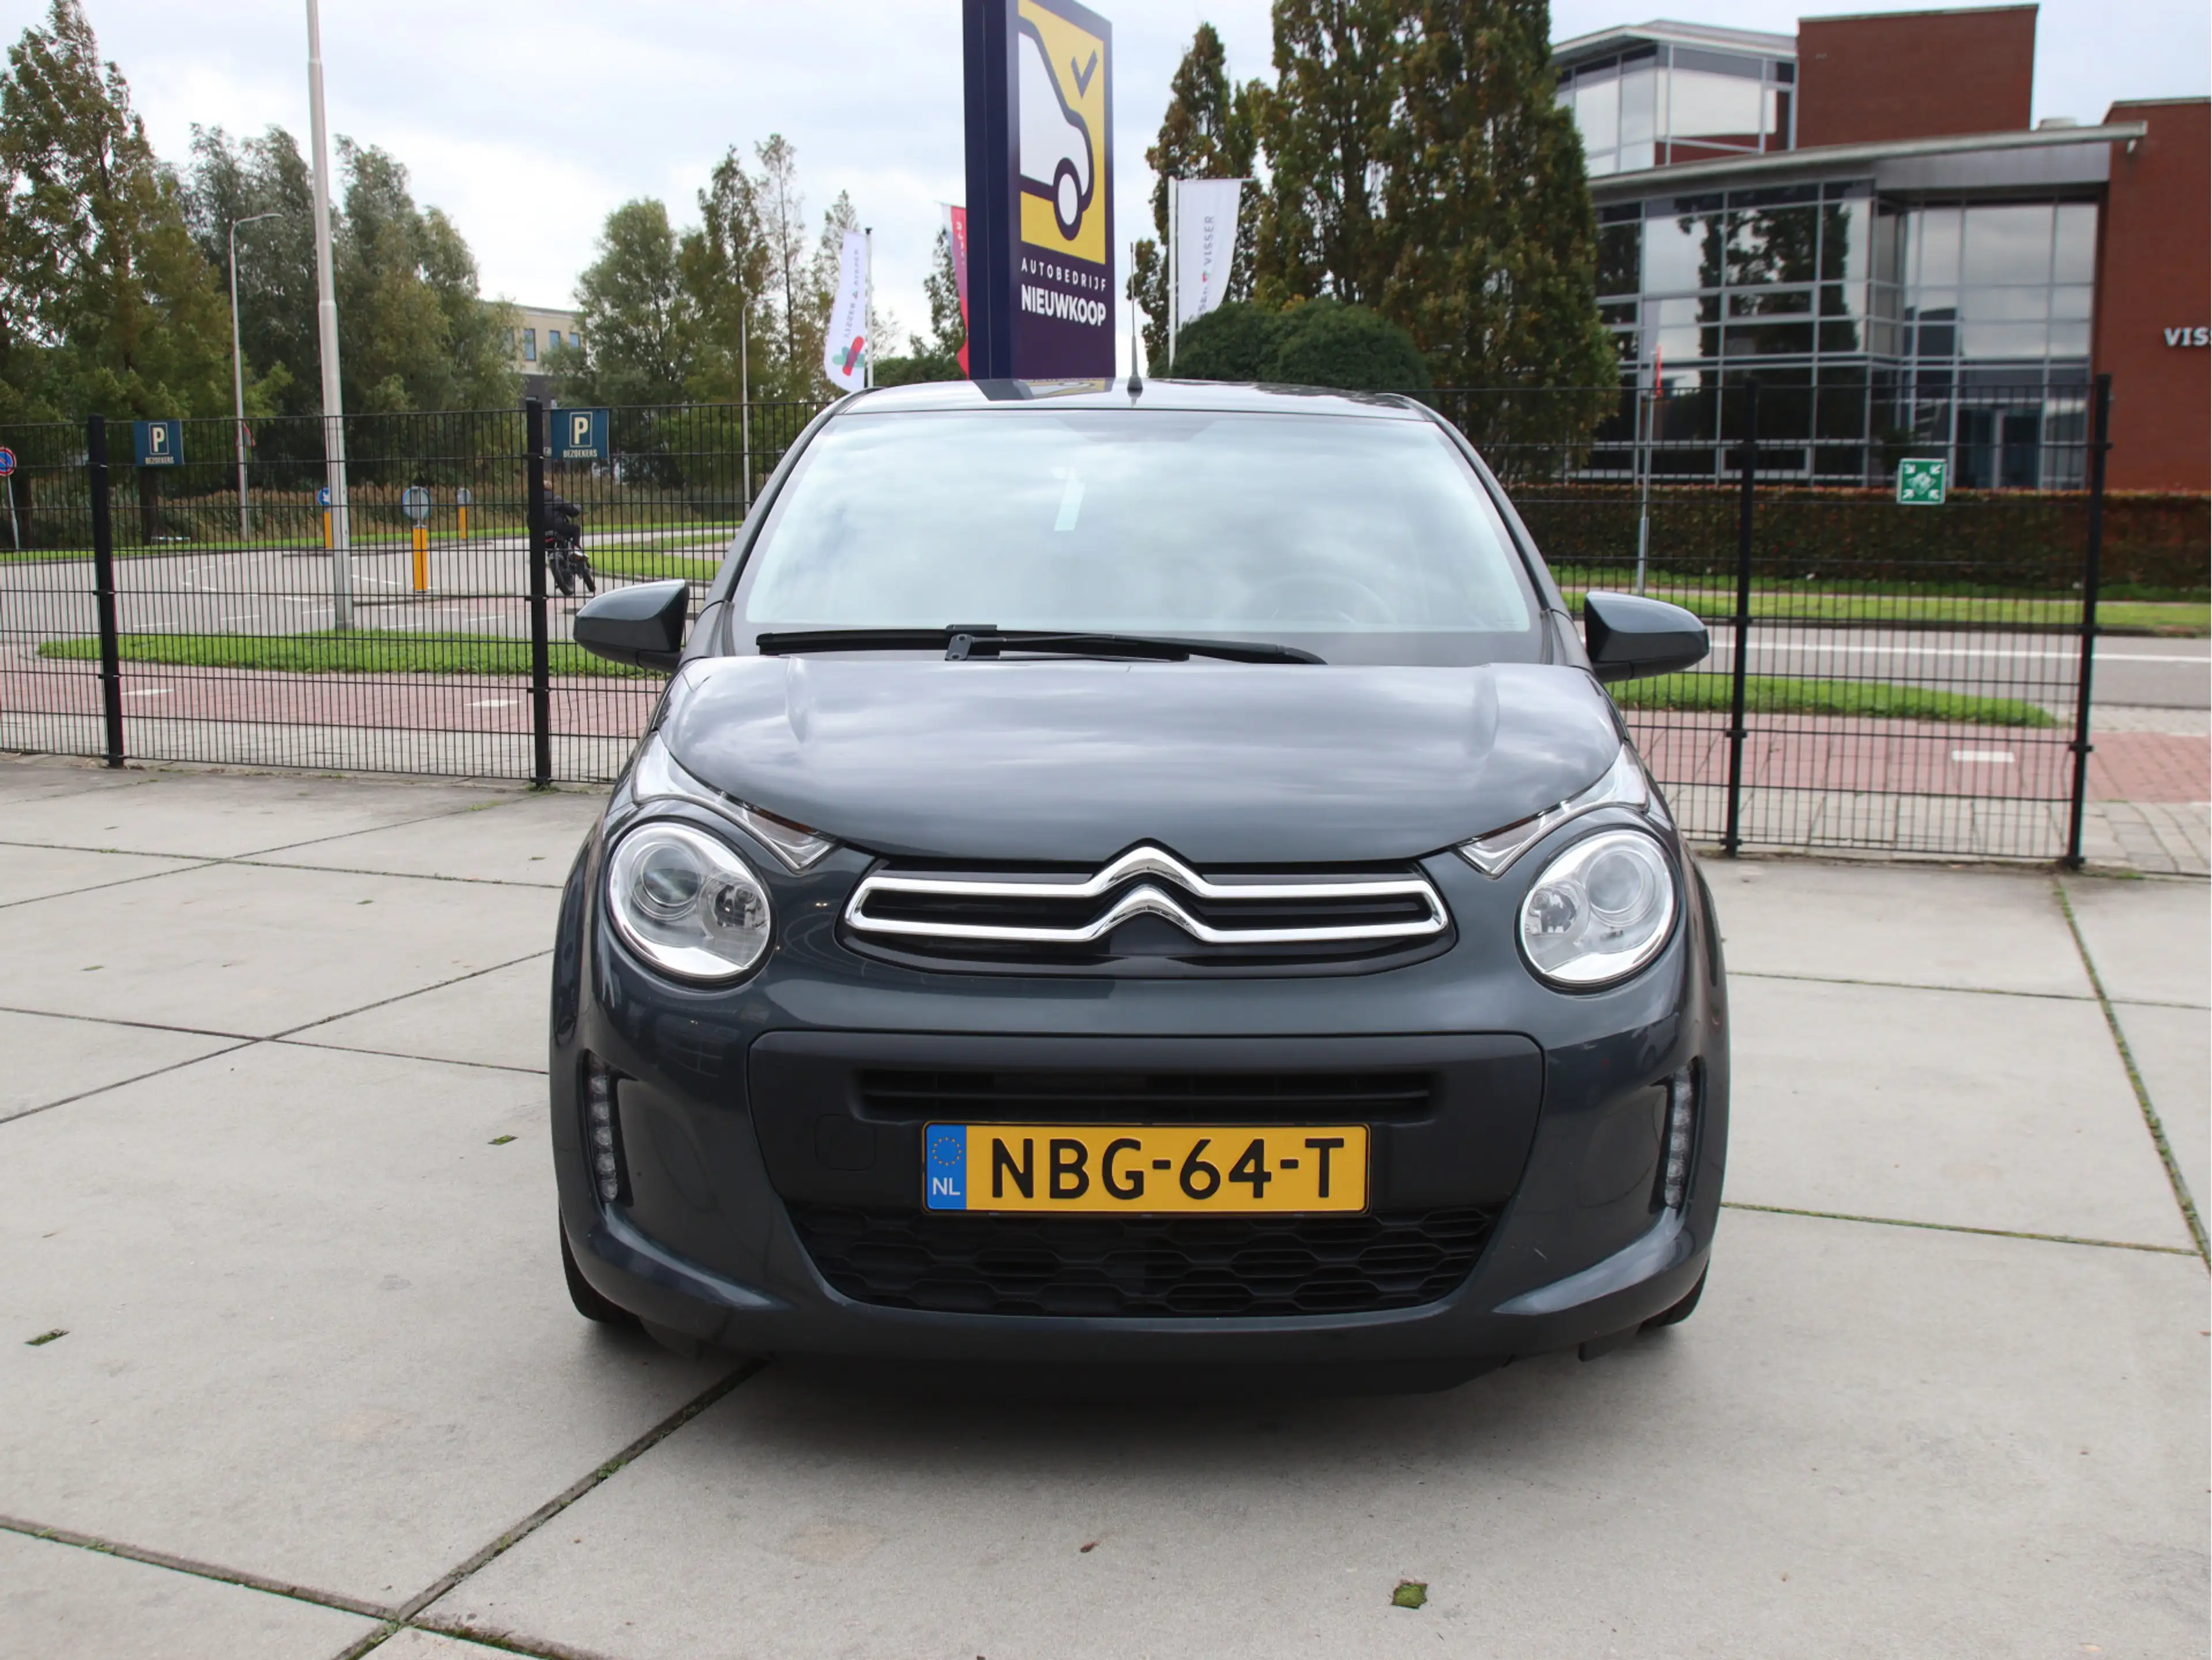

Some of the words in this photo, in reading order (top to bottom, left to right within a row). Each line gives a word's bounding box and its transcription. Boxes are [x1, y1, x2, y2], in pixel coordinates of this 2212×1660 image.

[1203, 215, 1215, 265] VISSER
[1021, 257, 1107, 292] AUTOBEDRIJF
[1021, 284, 1106, 327] NIEUWKOOP
[2163, 327, 2211, 346] VIS
[153, 427, 165, 452] P
[574, 417, 588, 444] P
[992, 1137, 1344, 1200] NBG-64-T
[932, 1177, 961, 1195] NL
